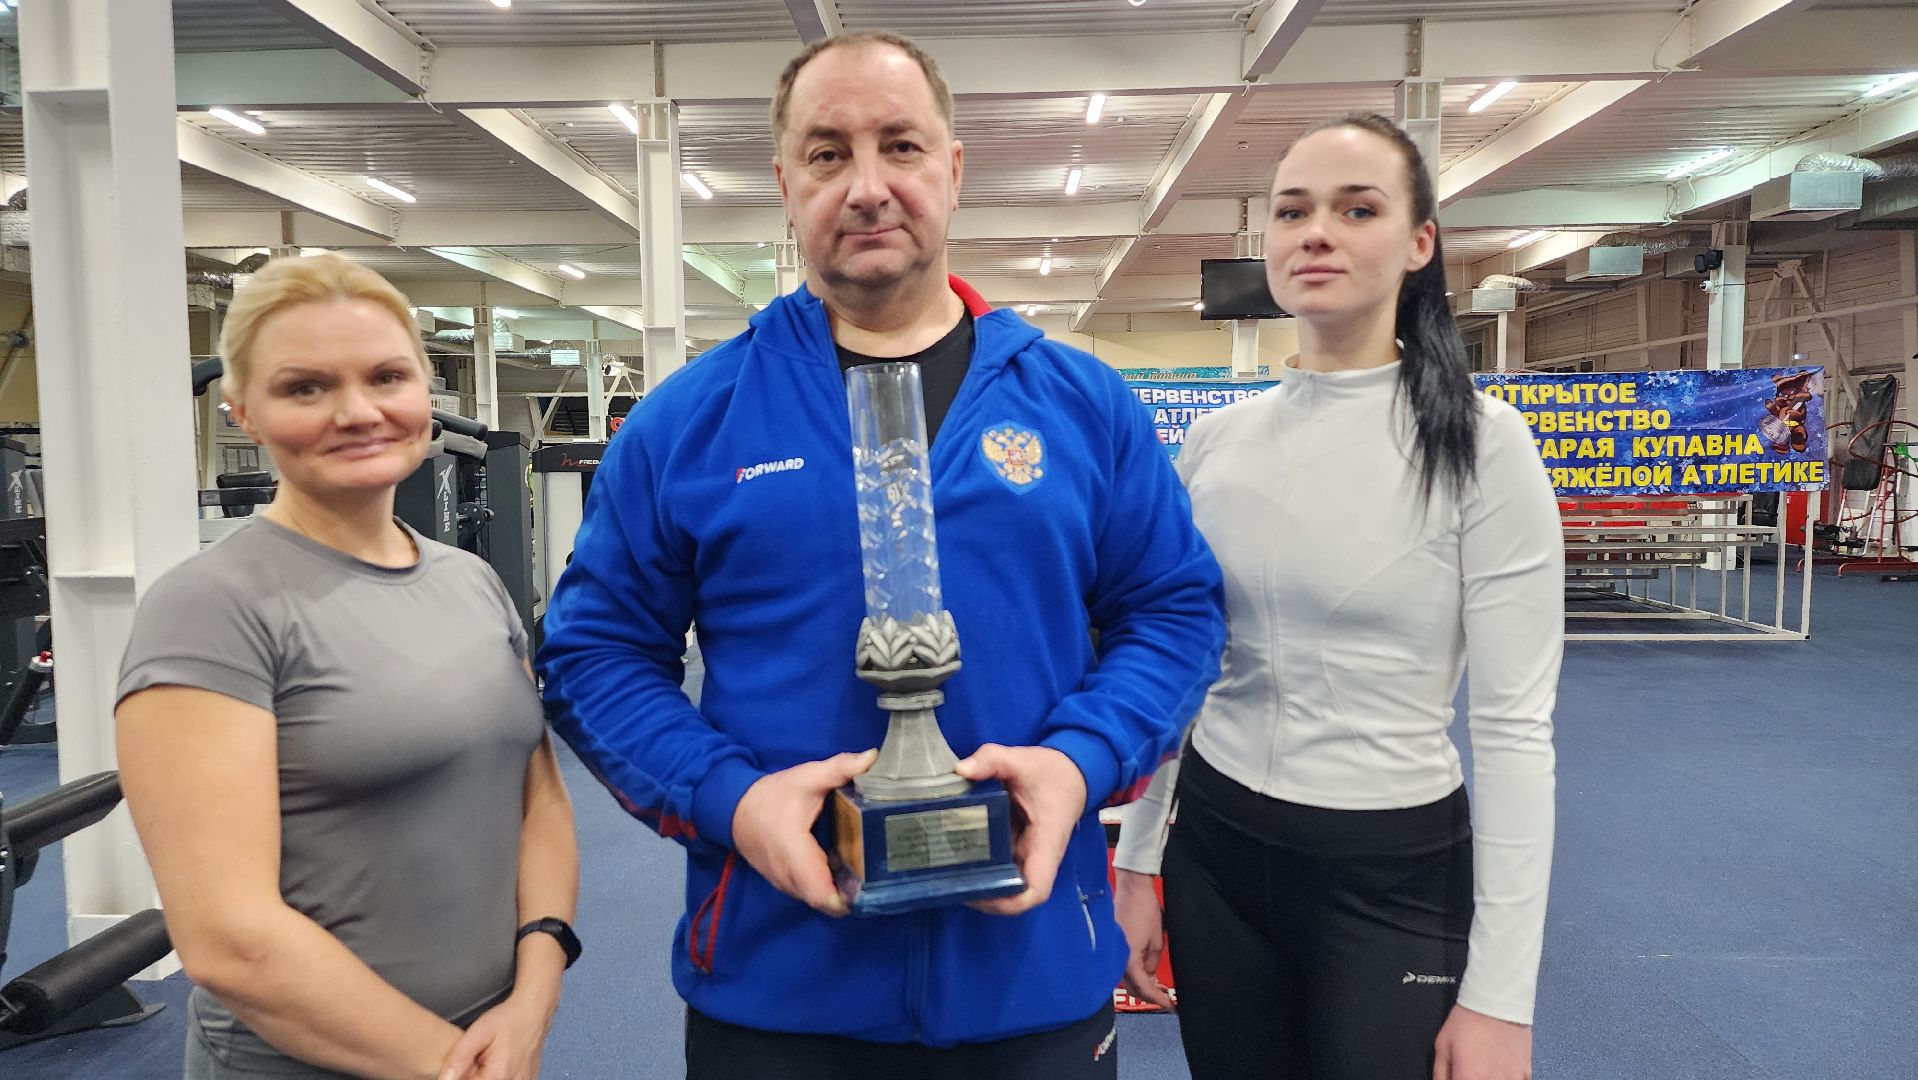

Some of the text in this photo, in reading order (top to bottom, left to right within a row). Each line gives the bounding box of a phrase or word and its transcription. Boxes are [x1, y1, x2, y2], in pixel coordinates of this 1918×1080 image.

[1485, 383, 1637, 404] ОТКРЫТОЕ
[1534, 434, 1765, 459] АРАЯ КУПАВНА
[735, 457, 805, 484] FORWARD
[1546, 462, 1824, 488] ЯЖЁЛОЙ АТЛЕТИКЕ
